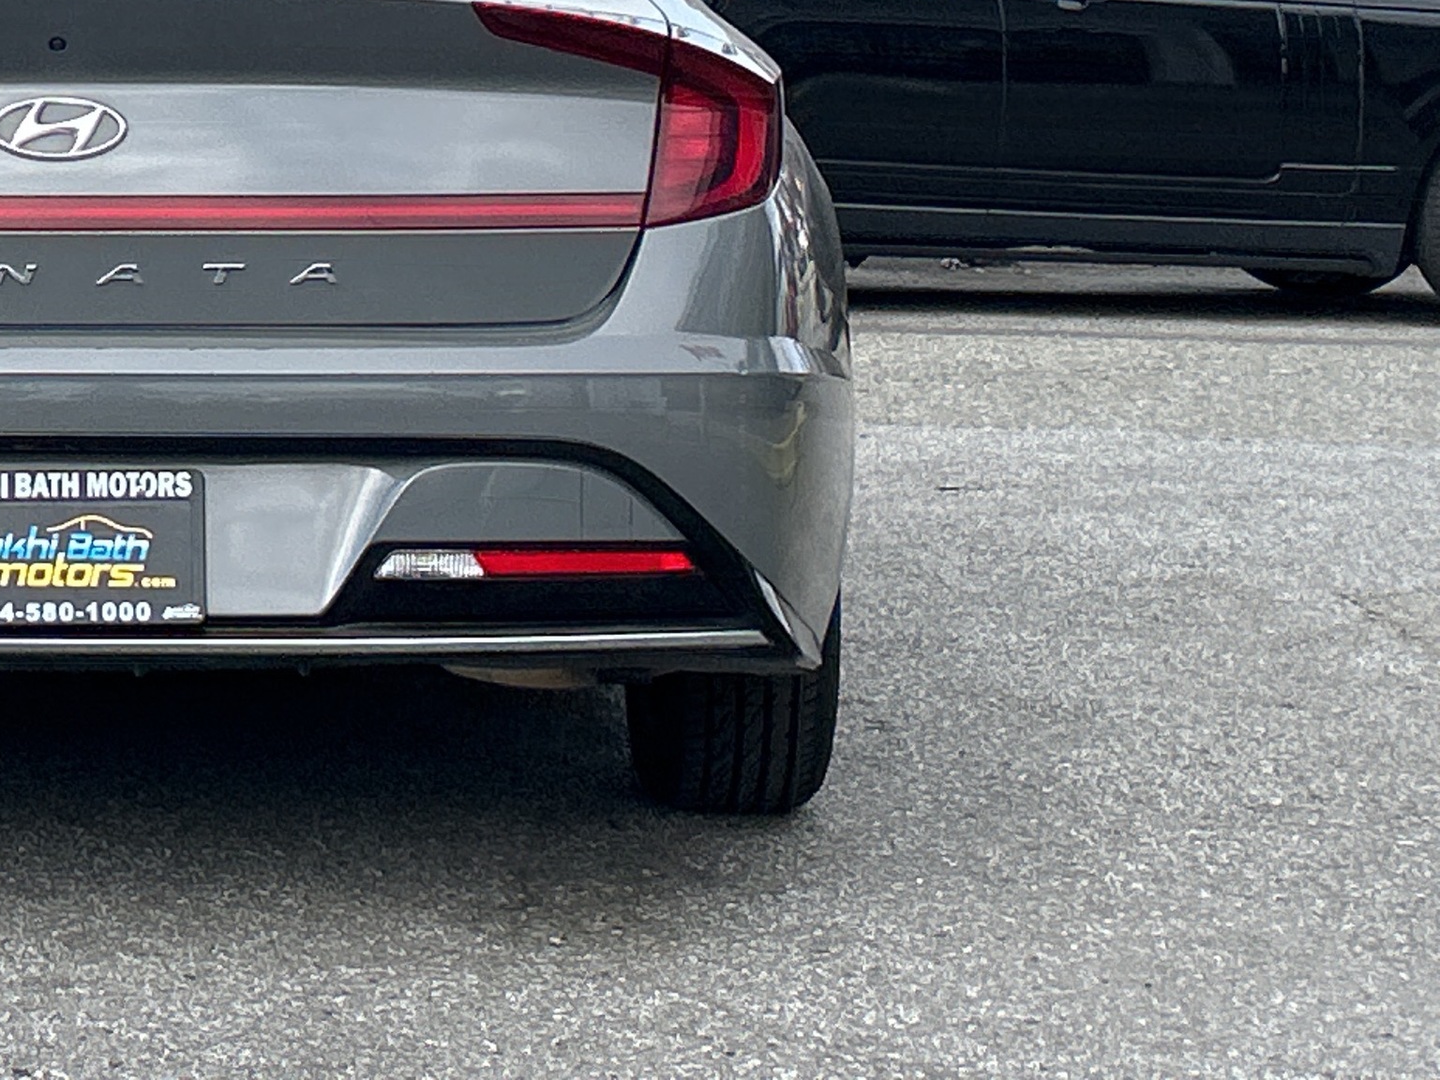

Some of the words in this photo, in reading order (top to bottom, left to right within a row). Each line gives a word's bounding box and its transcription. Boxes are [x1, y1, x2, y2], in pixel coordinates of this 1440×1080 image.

[14, 472, 80, 499] BATH
[86, 471, 193, 499] MOTORS
[67, 531, 150, 561] Bath
